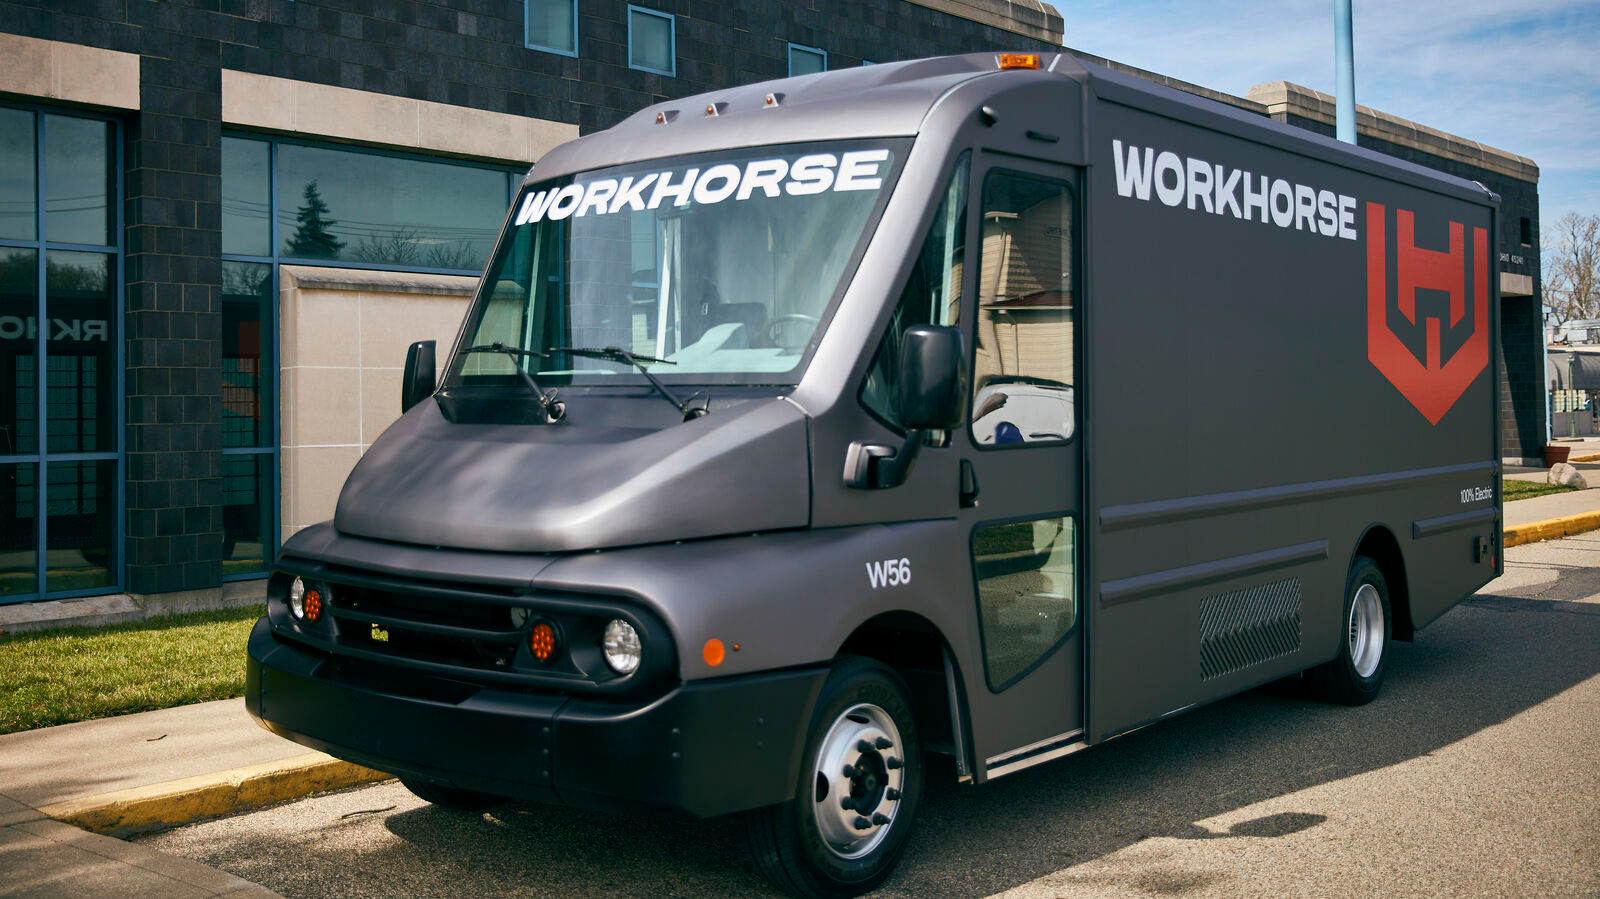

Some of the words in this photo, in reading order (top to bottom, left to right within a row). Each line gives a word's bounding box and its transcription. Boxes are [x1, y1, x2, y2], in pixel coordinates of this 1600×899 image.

[515, 149, 890, 226] WORKHORSE
[1112, 139, 1357, 241] WORKHORSE
[1460, 488, 1474, 503] 100%
[1474, 485, 1493, 501] Electric
[866, 557, 911, 589] W56
